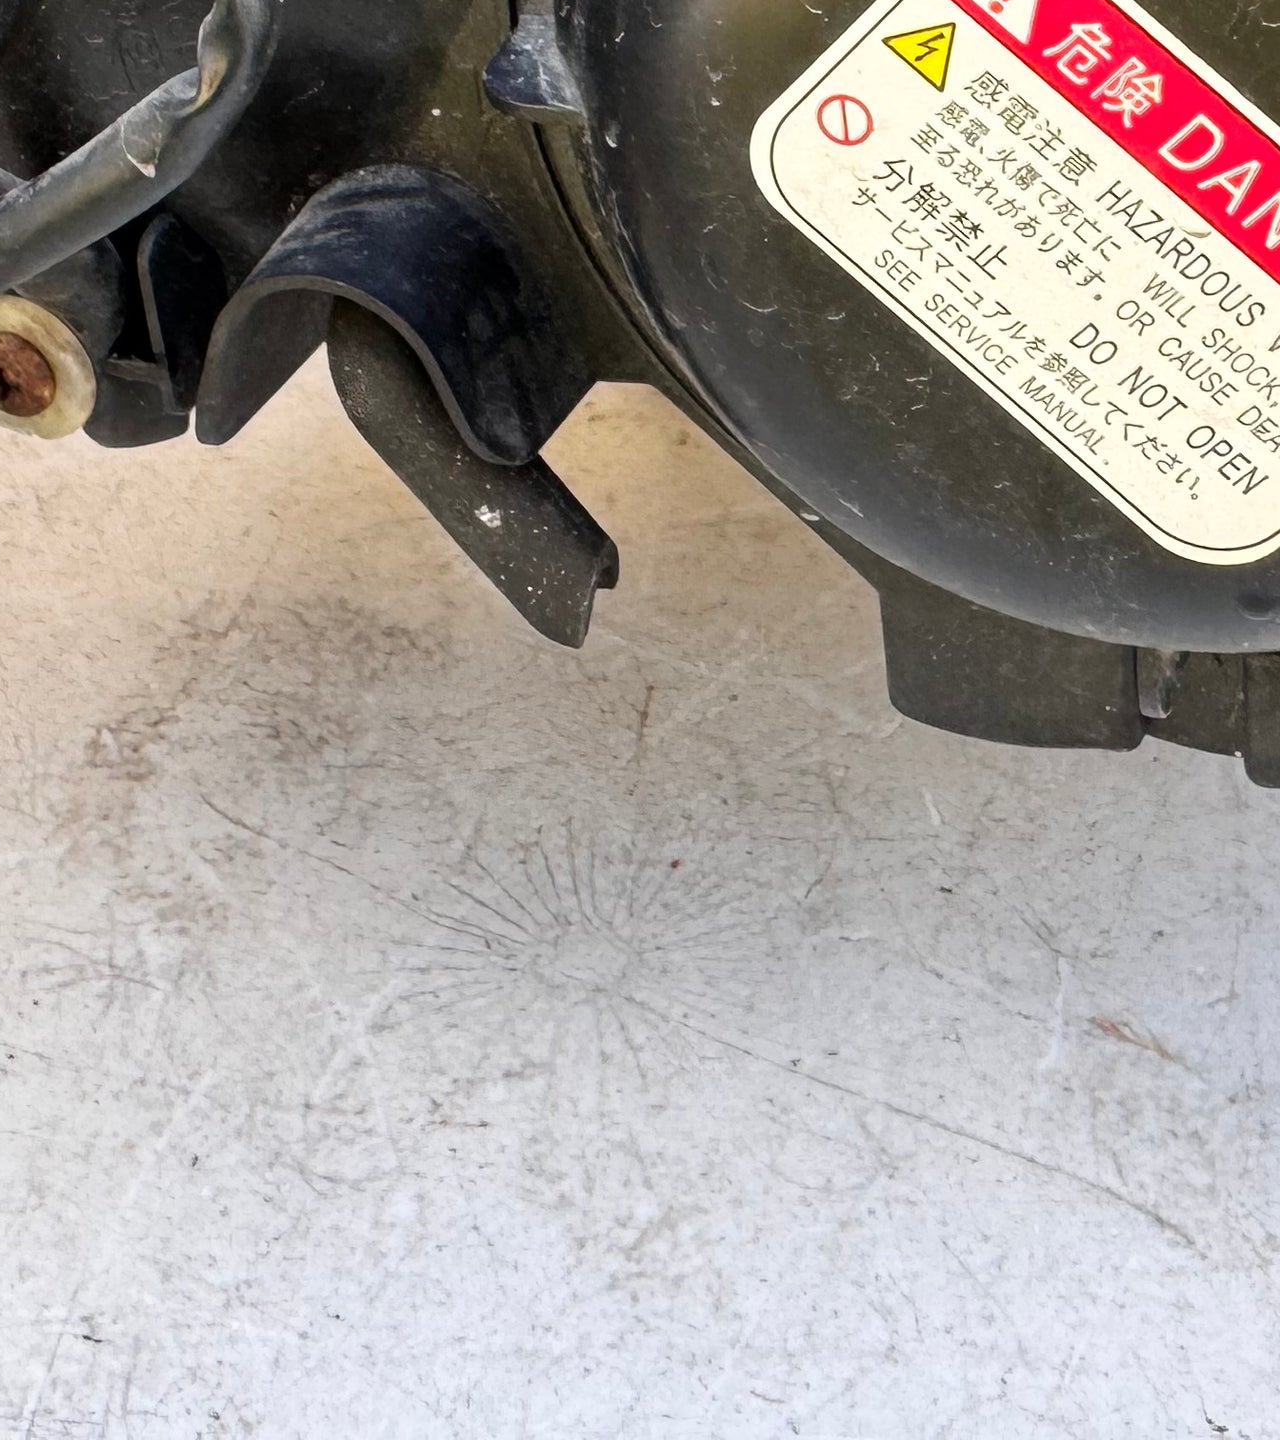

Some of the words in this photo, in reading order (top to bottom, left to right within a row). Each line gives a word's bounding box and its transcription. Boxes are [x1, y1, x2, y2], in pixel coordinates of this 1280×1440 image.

[964, 71, 1097, 186] 感電注意
[1043, 23, 1162, 127] 危険
[873, 160, 1007, 280] 分解禁止
[911, 125, 1105, 300] 至る恐れがあります。
[1096, 181, 1265, 326] HAZARDOUS
[852, 188, 1197, 499] サービスマニュアルを参照してください。
[875, 250, 921, 292] SEE
[925, 294, 1018, 374] SERVICE
[1117, 301, 1154, 336] OR
[1159, 338, 1238, 405] CAUSE
[1143, 275, 1195, 327] WILL
[1069, 323, 1117, 364] DO
[1118, 366, 1186, 420] NOT
[1187, 426, 1268, 494] OPEN
